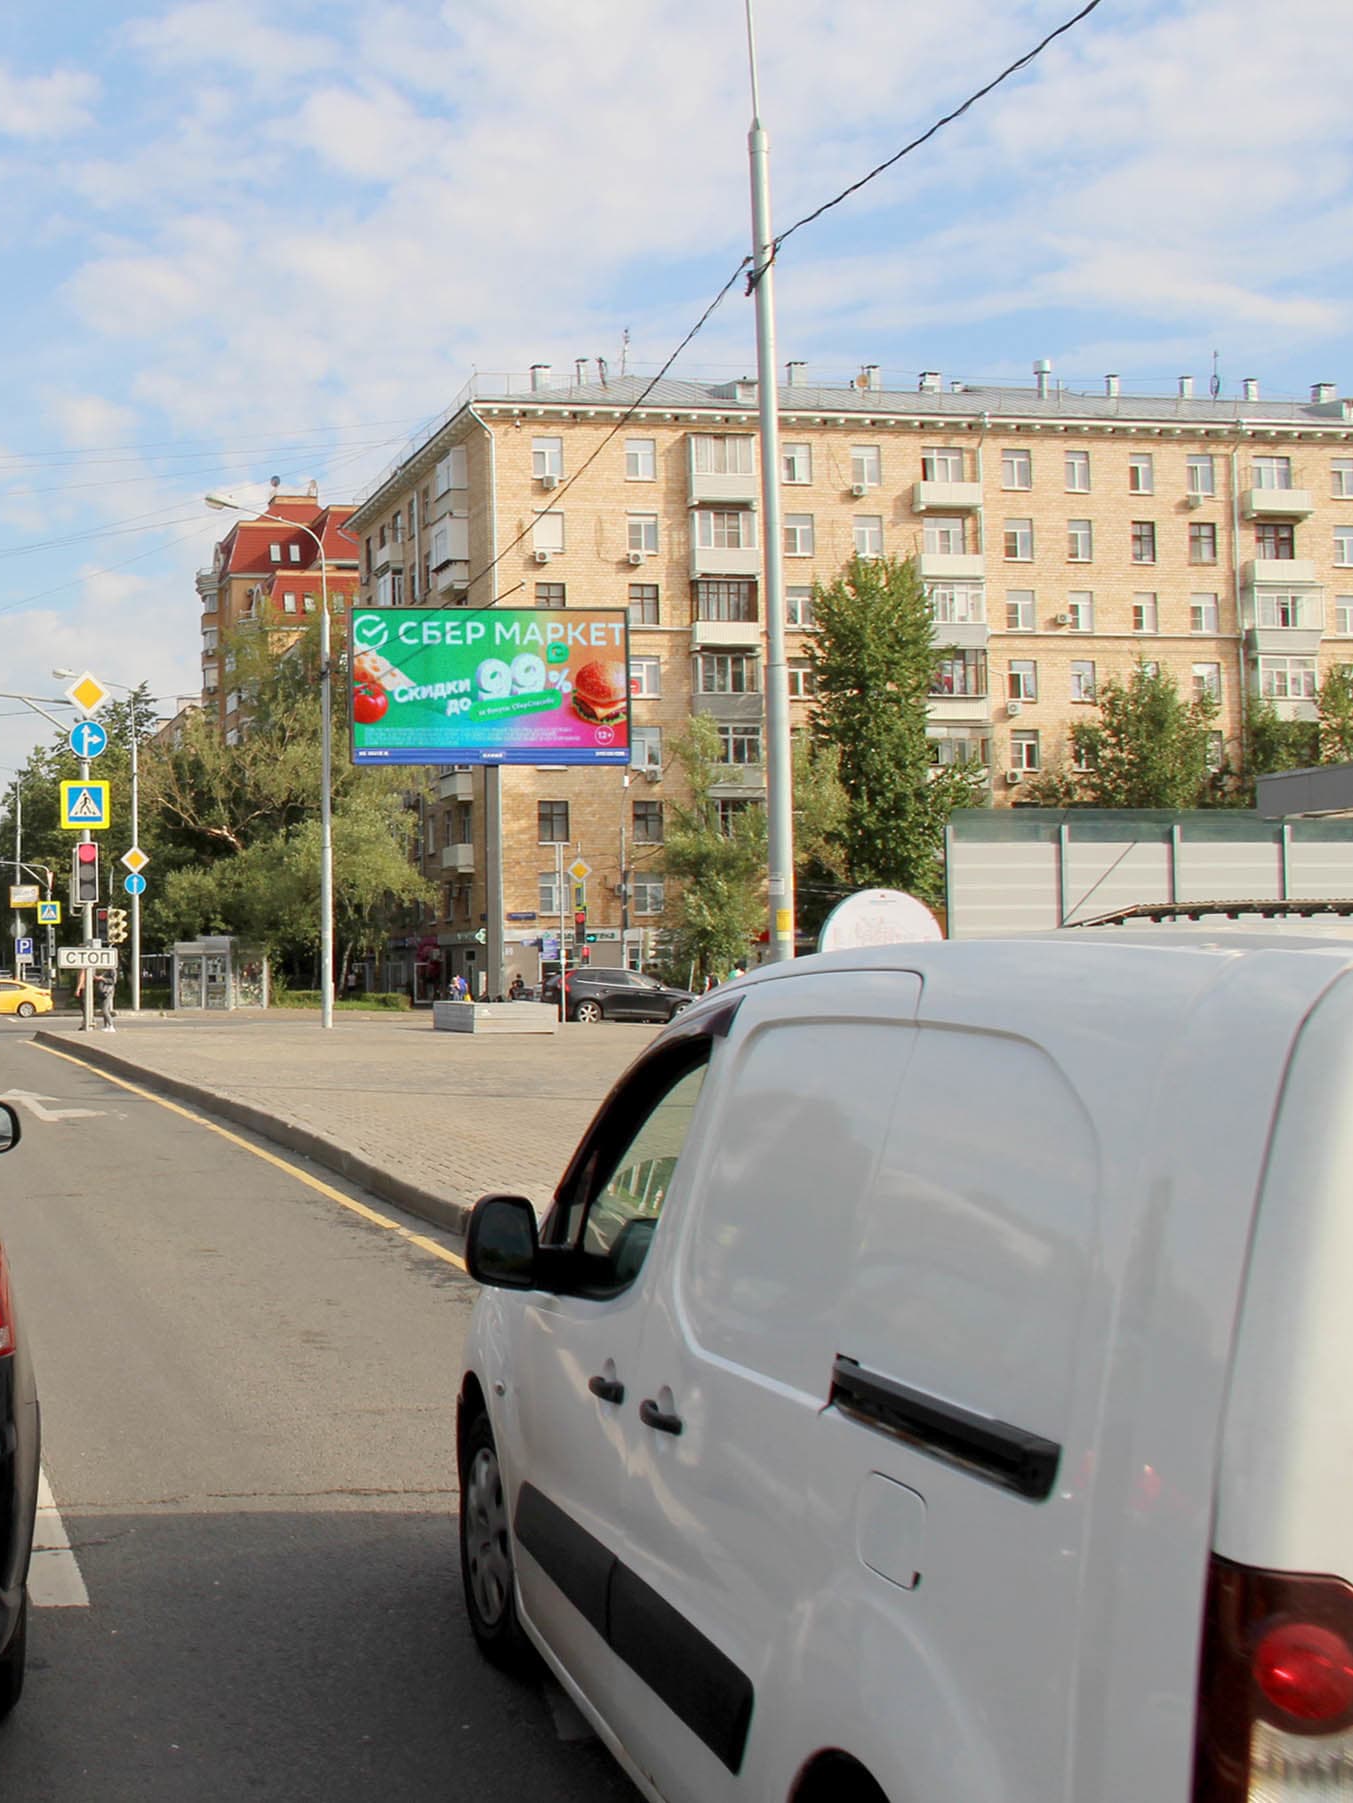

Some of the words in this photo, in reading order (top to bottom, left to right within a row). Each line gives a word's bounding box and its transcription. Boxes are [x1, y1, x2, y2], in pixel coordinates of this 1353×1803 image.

[399, 621, 485, 645] СБЕР
[494, 621, 625, 645] МАРКЕТ
[394, 679, 470, 703] Скидки
[446, 697, 472, 717] до
[66, 951, 110, 964] СТОП
